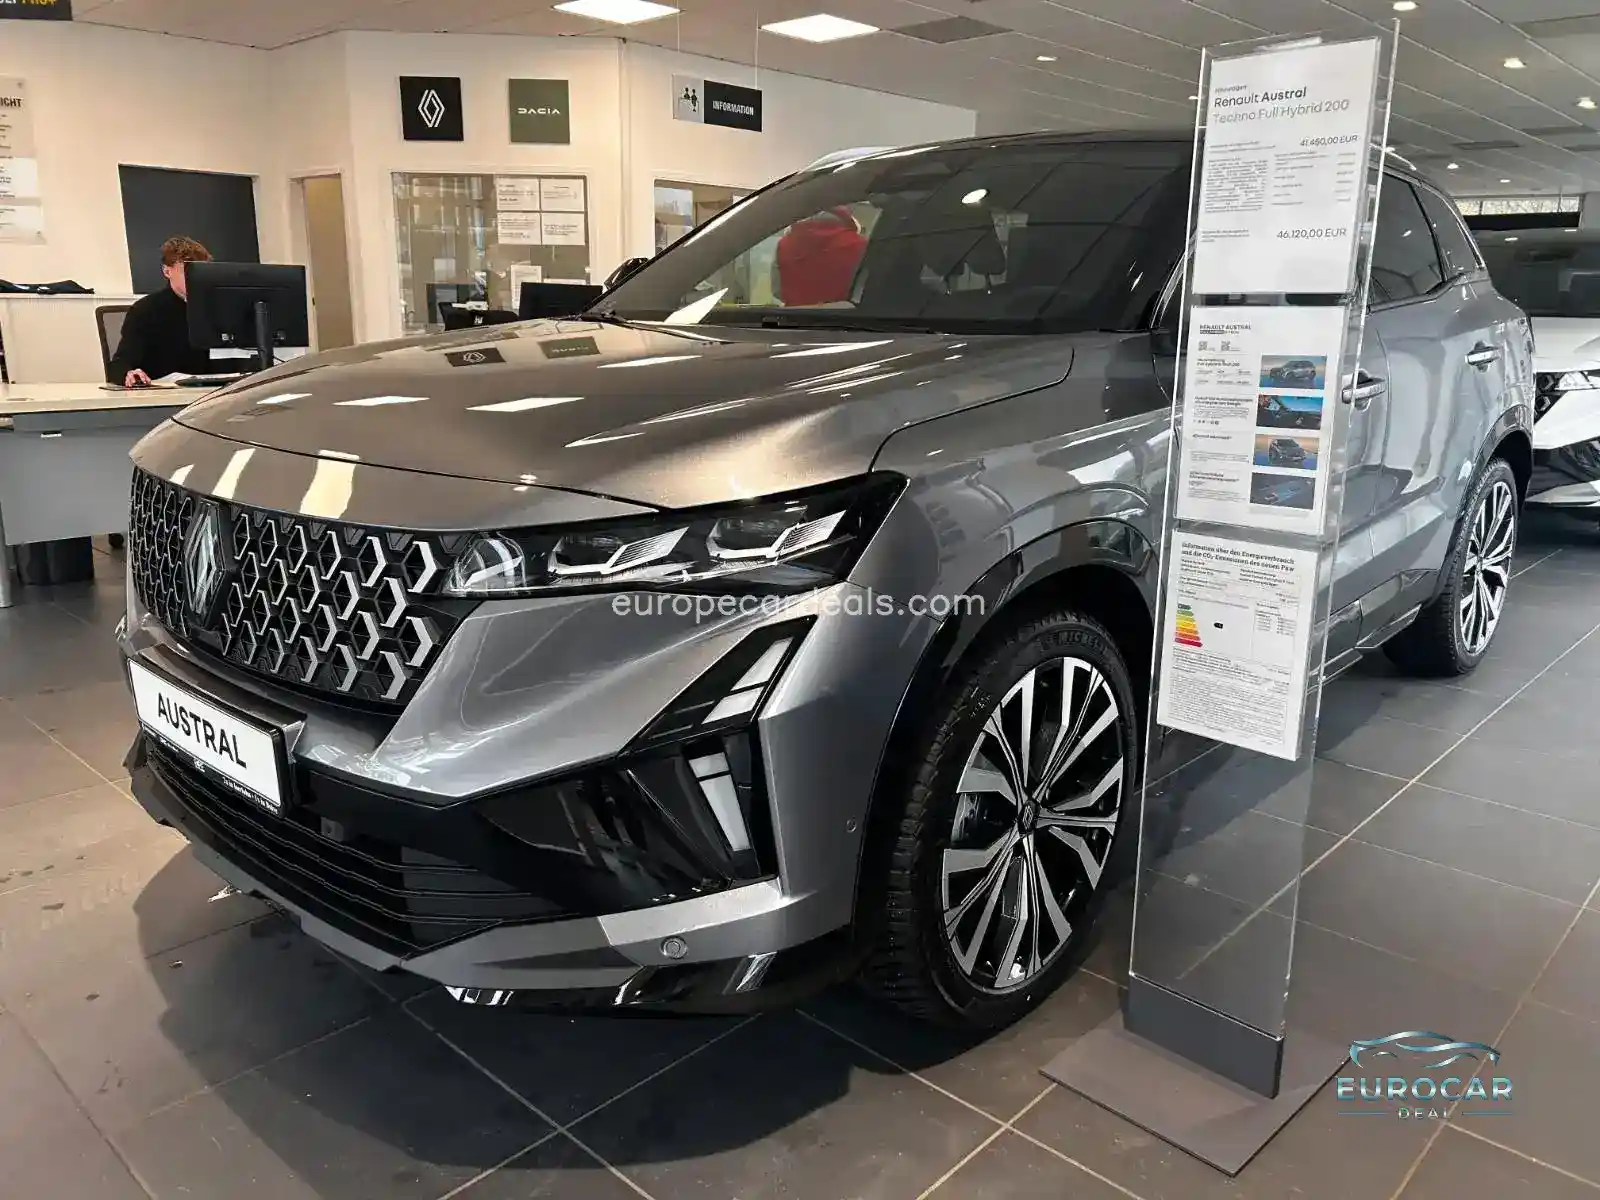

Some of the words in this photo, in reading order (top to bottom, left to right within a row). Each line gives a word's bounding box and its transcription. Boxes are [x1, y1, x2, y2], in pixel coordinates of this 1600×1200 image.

[1214, 92, 1260, 107] Renault
[1261, 87, 1307, 102] Austral
[517, 107, 561, 115] DACIA
[712, 100, 754, 116] INFORMATION
[1213, 111, 1256, 124] Techno
[1258, 107, 1279, 120] Full
[1280, 101, 1323, 118] Hybrid
[1324, 99, 1350, 112] 200
[1340, 134, 1358, 144] EUR
[1276, 228, 1323, 239] 46.120,00
[1325, 227, 1347, 238] EUR
[157, 692, 247, 769] AUSTRAL
